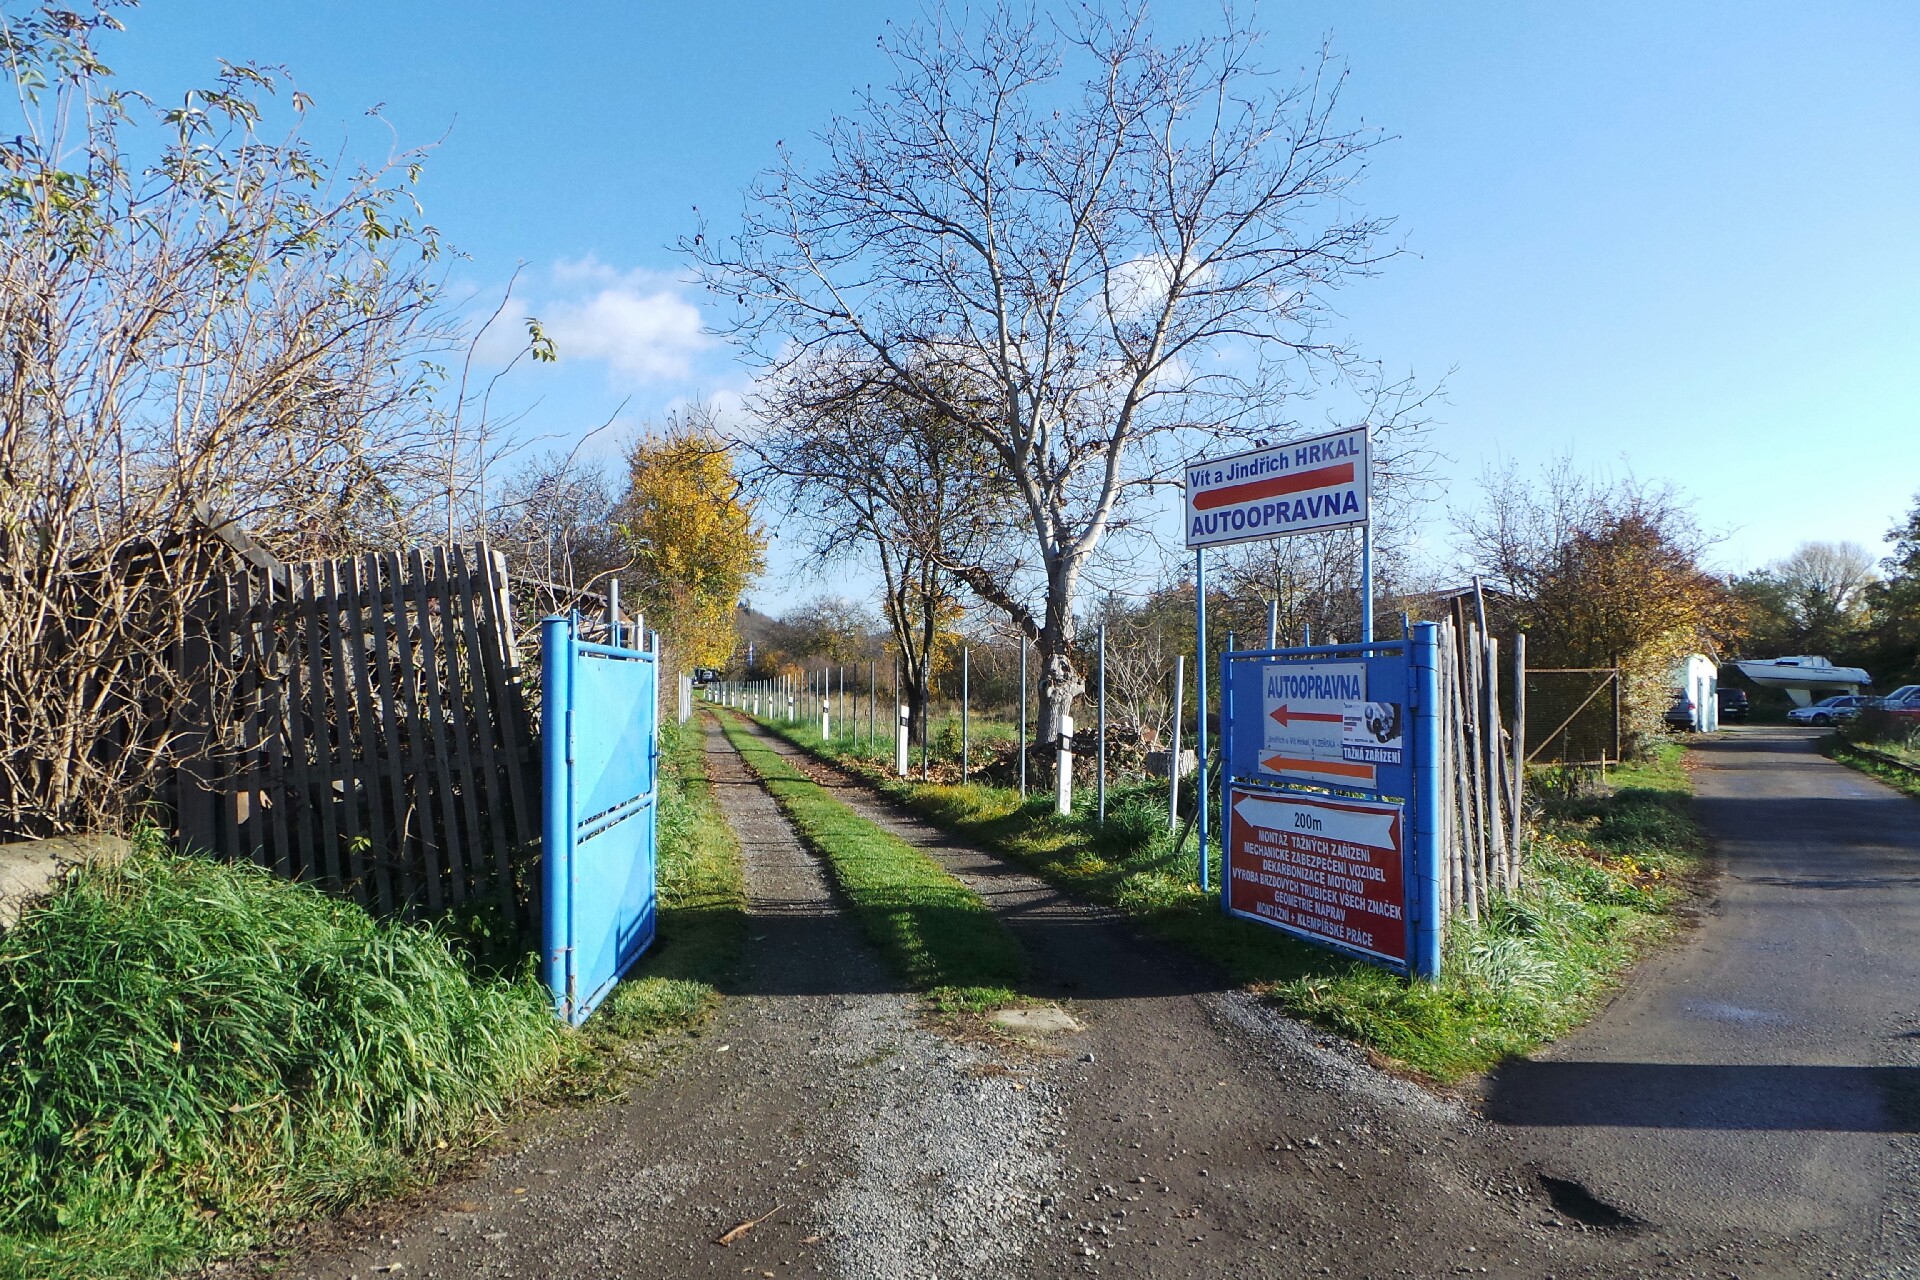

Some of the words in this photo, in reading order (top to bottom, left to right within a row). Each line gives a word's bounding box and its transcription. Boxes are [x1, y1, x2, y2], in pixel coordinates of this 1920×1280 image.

[1190, 470, 1211, 488] Vít
[1214, 472, 1222, 484] a
[1226, 452, 1288, 482] Jindřich
[1295, 437, 1360, 467] HRKAL
[1191, 490, 1360, 537] AUTOOPRAVNA
[1267, 674, 1361, 700] AUTOOPRAVNA
[1344, 746, 1364, 760] TAŽNÁ
[1365, 748, 1400, 764] ZAŘÍZENÍ
[1294, 812, 1322, 832] 200m
[1244, 842, 1290, 862] MECHANICKÉ
[1292, 852, 1346, 874] ZABEZPEČENÍ
[1348, 863, 1386, 882] VOZIDEL
[1258, 830, 1288, 846] MONTÁŽ
[1292, 836, 1328, 855] TAŽNÝCH
[1331, 843, 1370, 862] ZAŘÍZENÍ
[1232, 867, 1259, 884] VÝROBA
[1260, 874, 1298, 894] BRZDOVÝCH
[1300, 882, 1338, 904] TRUBIČEK
[1339, 891, 1366, 911] VŠECH
[1368, 900, 1402, 920] ZNAČEK
[1262, 859, 1325, 884] DEKARBONIZACE
[1328, 874, 1364, 894] MOTORŮ
[1274, 890, 1313, 912] GEOMETRIE
[1315, 901, 1346, 922] NÁPRAV
[1256, 902, 1290, 922] MONTÁŽNÍ
[1291, 913, 1295, 922] +
[1296, 912, 1344, 938] KLEMPÍŘSKÉ
[1346, 927, 1373, 947] PRÁCE
